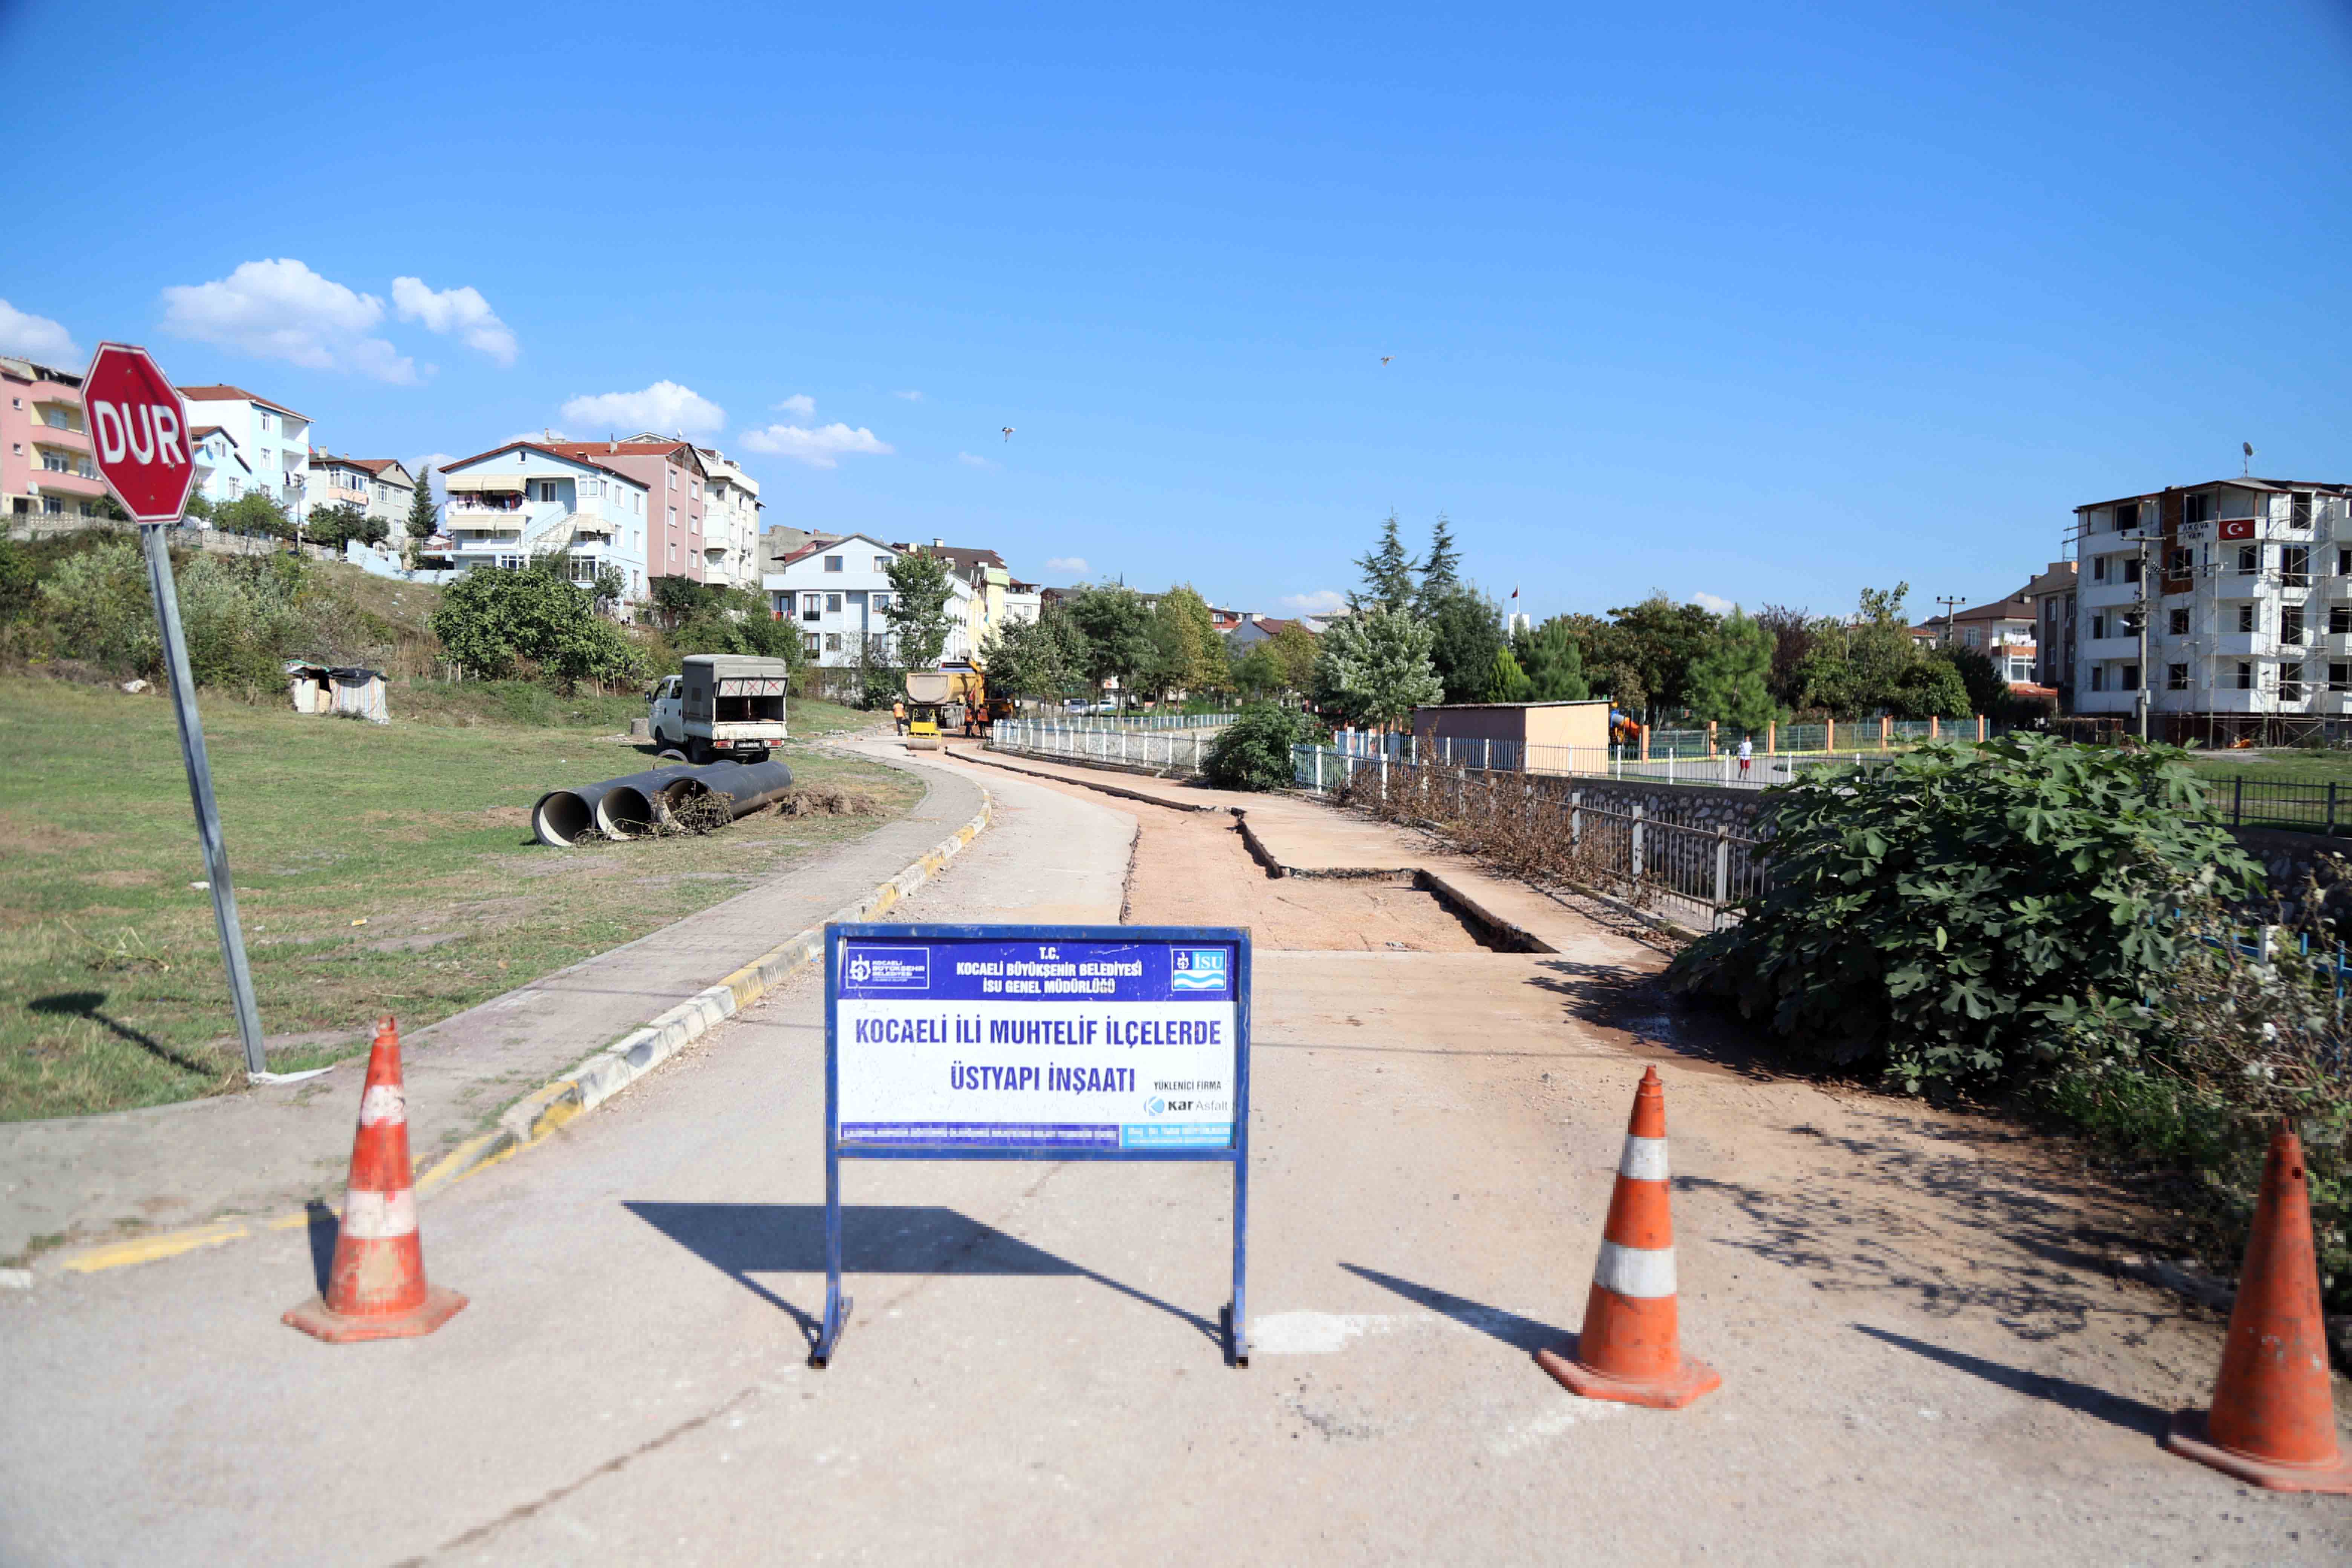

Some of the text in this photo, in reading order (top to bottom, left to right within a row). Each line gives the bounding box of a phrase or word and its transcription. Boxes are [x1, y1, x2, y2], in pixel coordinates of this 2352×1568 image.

[94, 401, 186, 465] DUR
[1039, 946, 1060, 959] T.C.
[956, 960, 1142, 978] KOCAELİ BÜYÜKŞEHİR BELEDİYESİ
[983, 977, 1115, 994] İSU GENEL MÜDÜRLÜĞÜ
[856, 1014, 1221, 1049] KOCAELİ İLİ MUHTELİF İLÇELERDE
[951, 1060, 1135, 1095] ÜSTYAPI İNŞAATI
[1153, 1079, 1222, 1090] YÜKLENİCİ FİRMA
[1196, 1099, 1228, 1111] Asfalt
